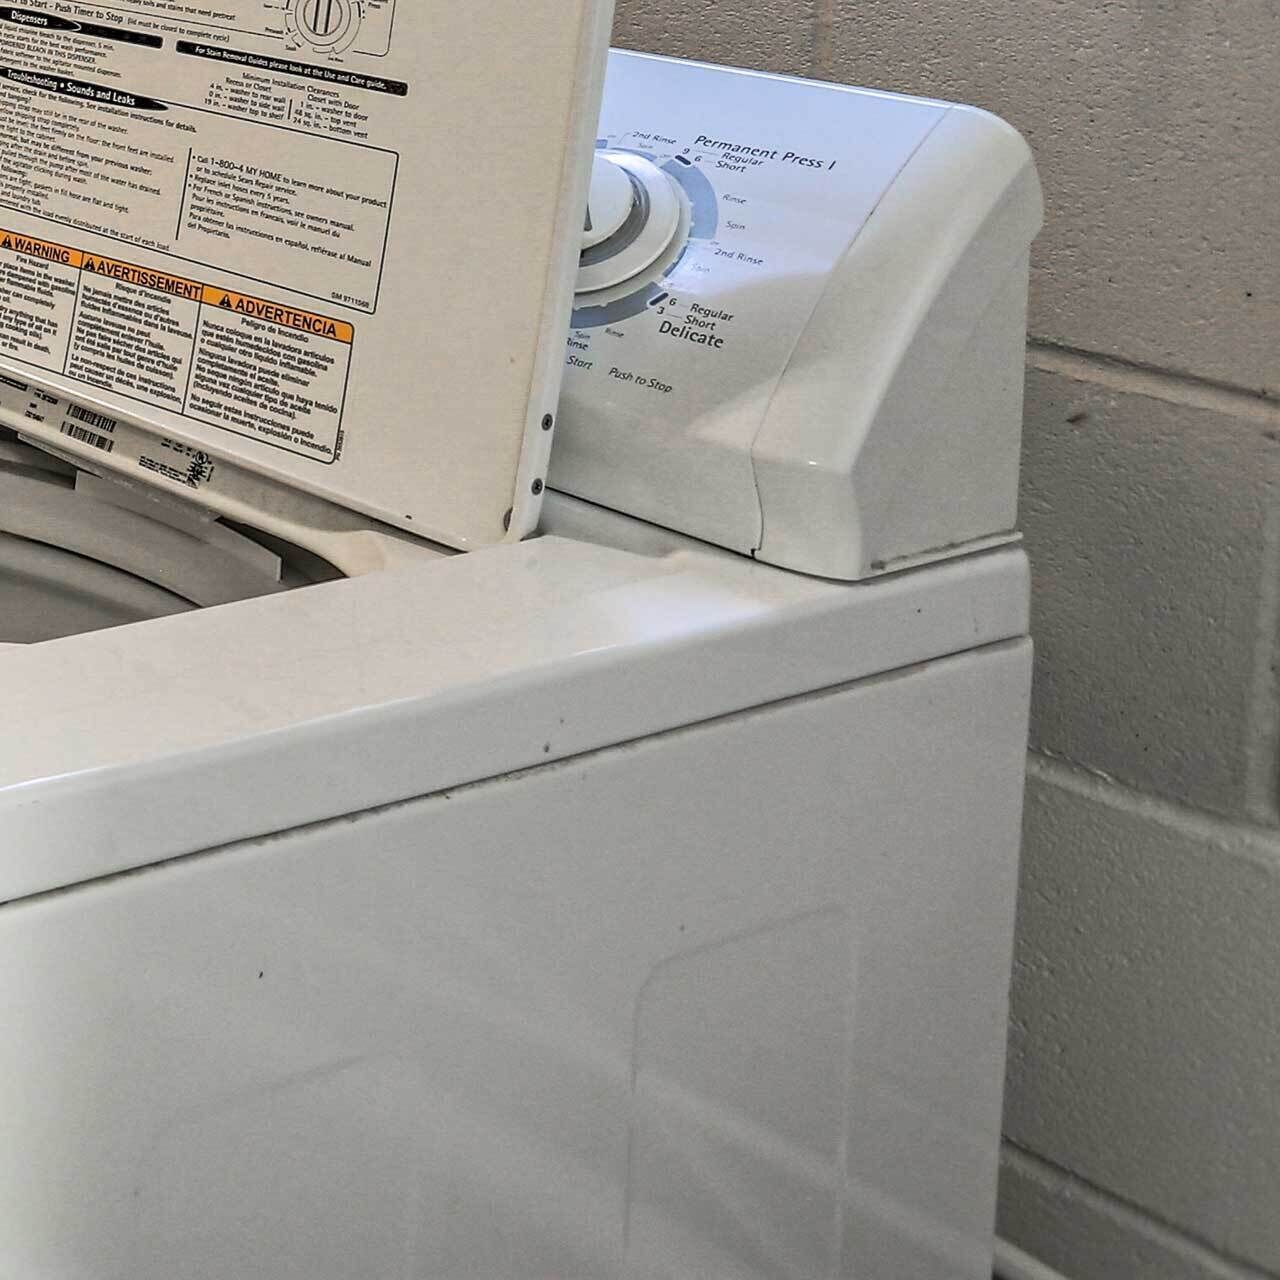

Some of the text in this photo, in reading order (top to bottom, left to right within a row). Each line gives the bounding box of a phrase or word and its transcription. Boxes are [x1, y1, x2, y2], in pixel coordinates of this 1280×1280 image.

[10, 9, 48, 26] Dispensers
[53, 1, 72, 13] Push
[72, 4, 94, 17] Timer
[104, 10, 124, 24] Stop
[194, 44, 206, 54] For
[205, 47, 222, 57] Stain
[221, 50, 247, 62] Removal
[268, 59, 288, 70] please
[311, 67, 323, 77] the
[323, 69, 336, 80] Use
[335, 73, 350, 82] and
[349, 74, 365, 85] Care
[5, 68, 135, 106] Troubleshooting Sounds and Leaks
[632, 131, 677, 145] 2nd Rinse
[694, 135, 779, 161] Permanent
[782, 151, 825, 170] Press
[694, 155, 747, 173] 6 Short
[721, 152, 765, 167] Regular
[244, 165, 258, 176] MY
[257, 168, 282, 183] HOME
[324, 187, 344, 198] about
[344, 192, 361, 201] your
[360, 196, 387, 208] product
[722, 193, 747, 205] Rinse
[725, 221, 746, 231] Spin
[14, 236, 70, 263] WARNING
[15, 253, 49, 270] Fire Hazard
[714, 248, 764, 266] 2nd Rinse
[95, 259, 201, 299] AVERTISSEMENT
[234, 297, 337, 338] ADVERTENCIA
[657, 306, 717, 331] 3 Short
[669, 297, 735, 322] 6 Regular
[239, 316, 266, 331] Peligro
[659, 320, 725, 349] Delicate
[566, 355, 593, 370] Start
[609, 367, 673, 394] Push to Stop
